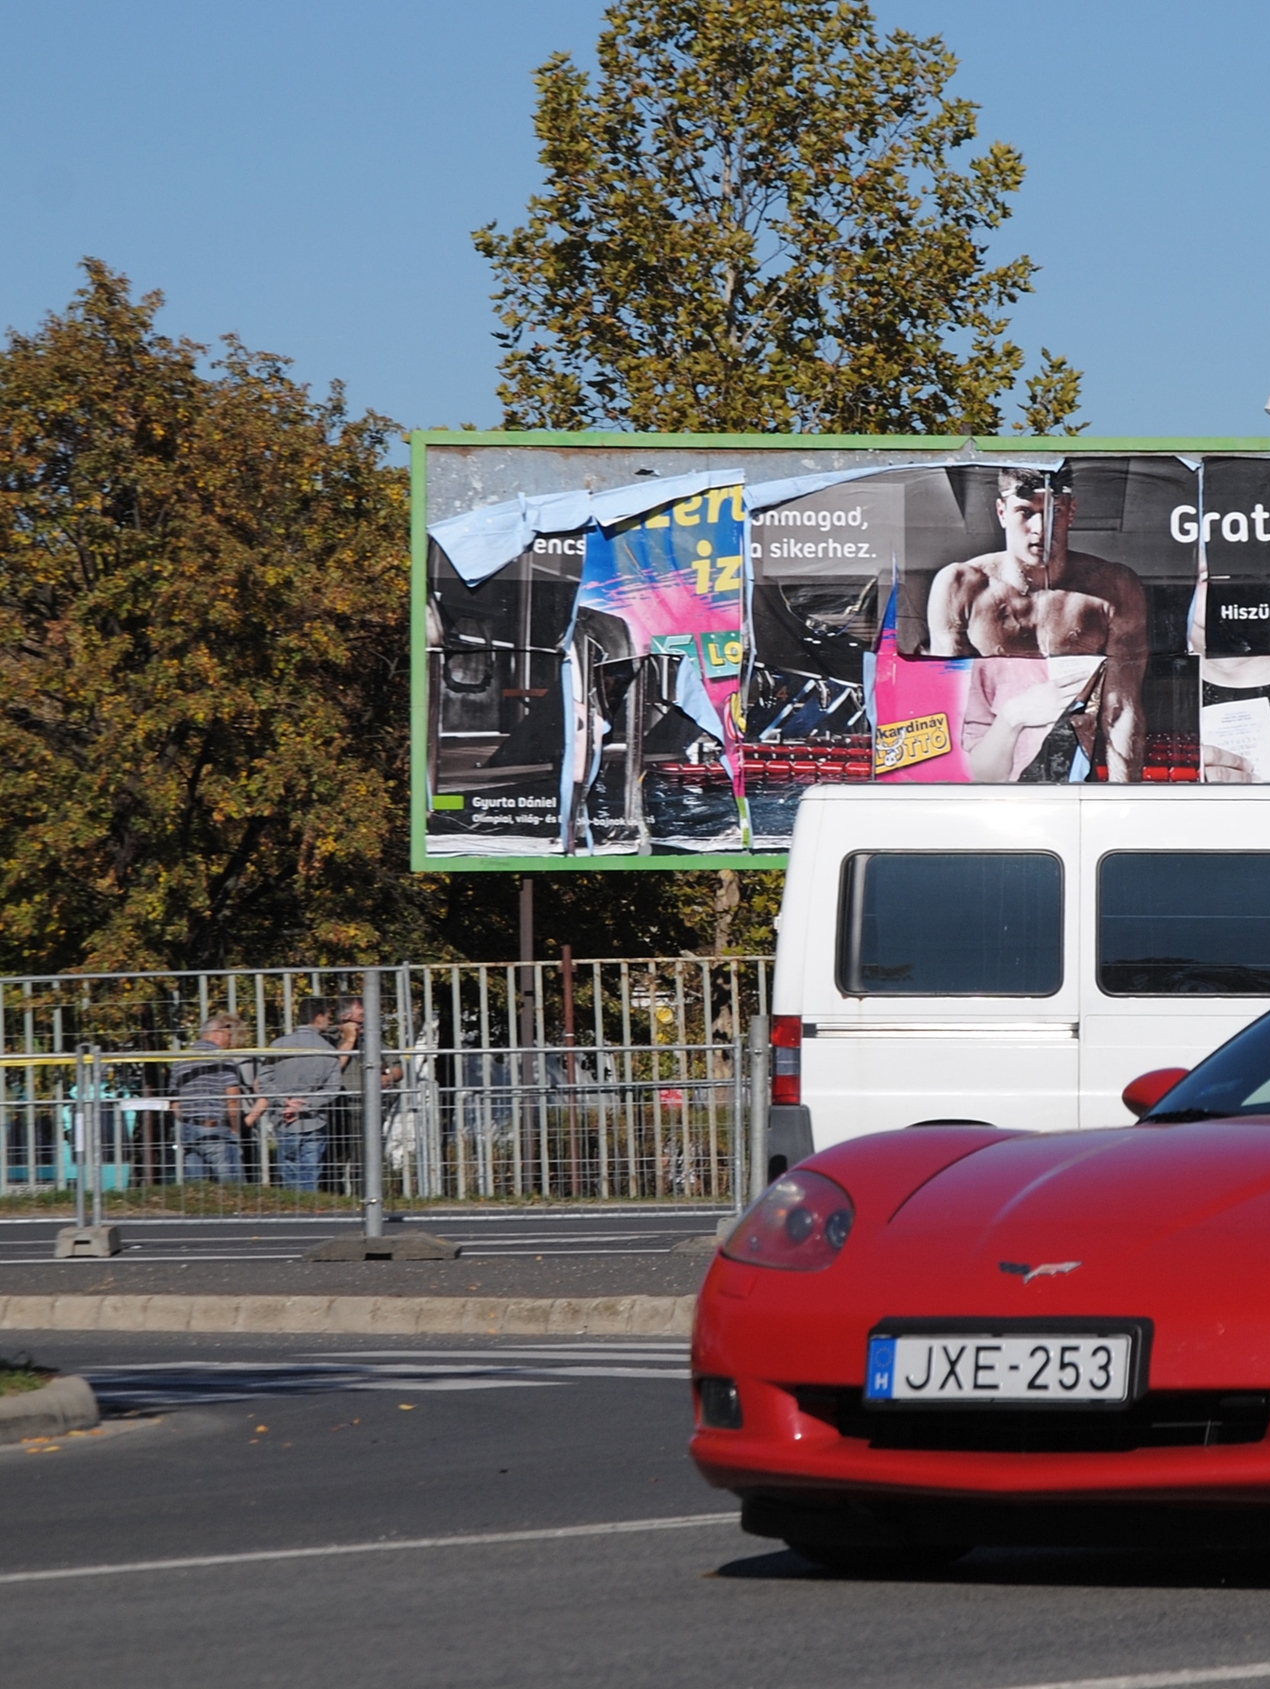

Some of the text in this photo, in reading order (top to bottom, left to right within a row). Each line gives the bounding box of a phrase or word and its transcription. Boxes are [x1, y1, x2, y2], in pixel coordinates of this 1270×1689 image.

[751, 542, 763, 557] a
[770, 538, 877, 557] sikerhez.
[691, 540, 743, 595] iz
[472, 795, 557, 811] Gyurta Dániel
[905, 1345, 1114, 1391] JXE-253
[875, 1373, 889, 1390] H
